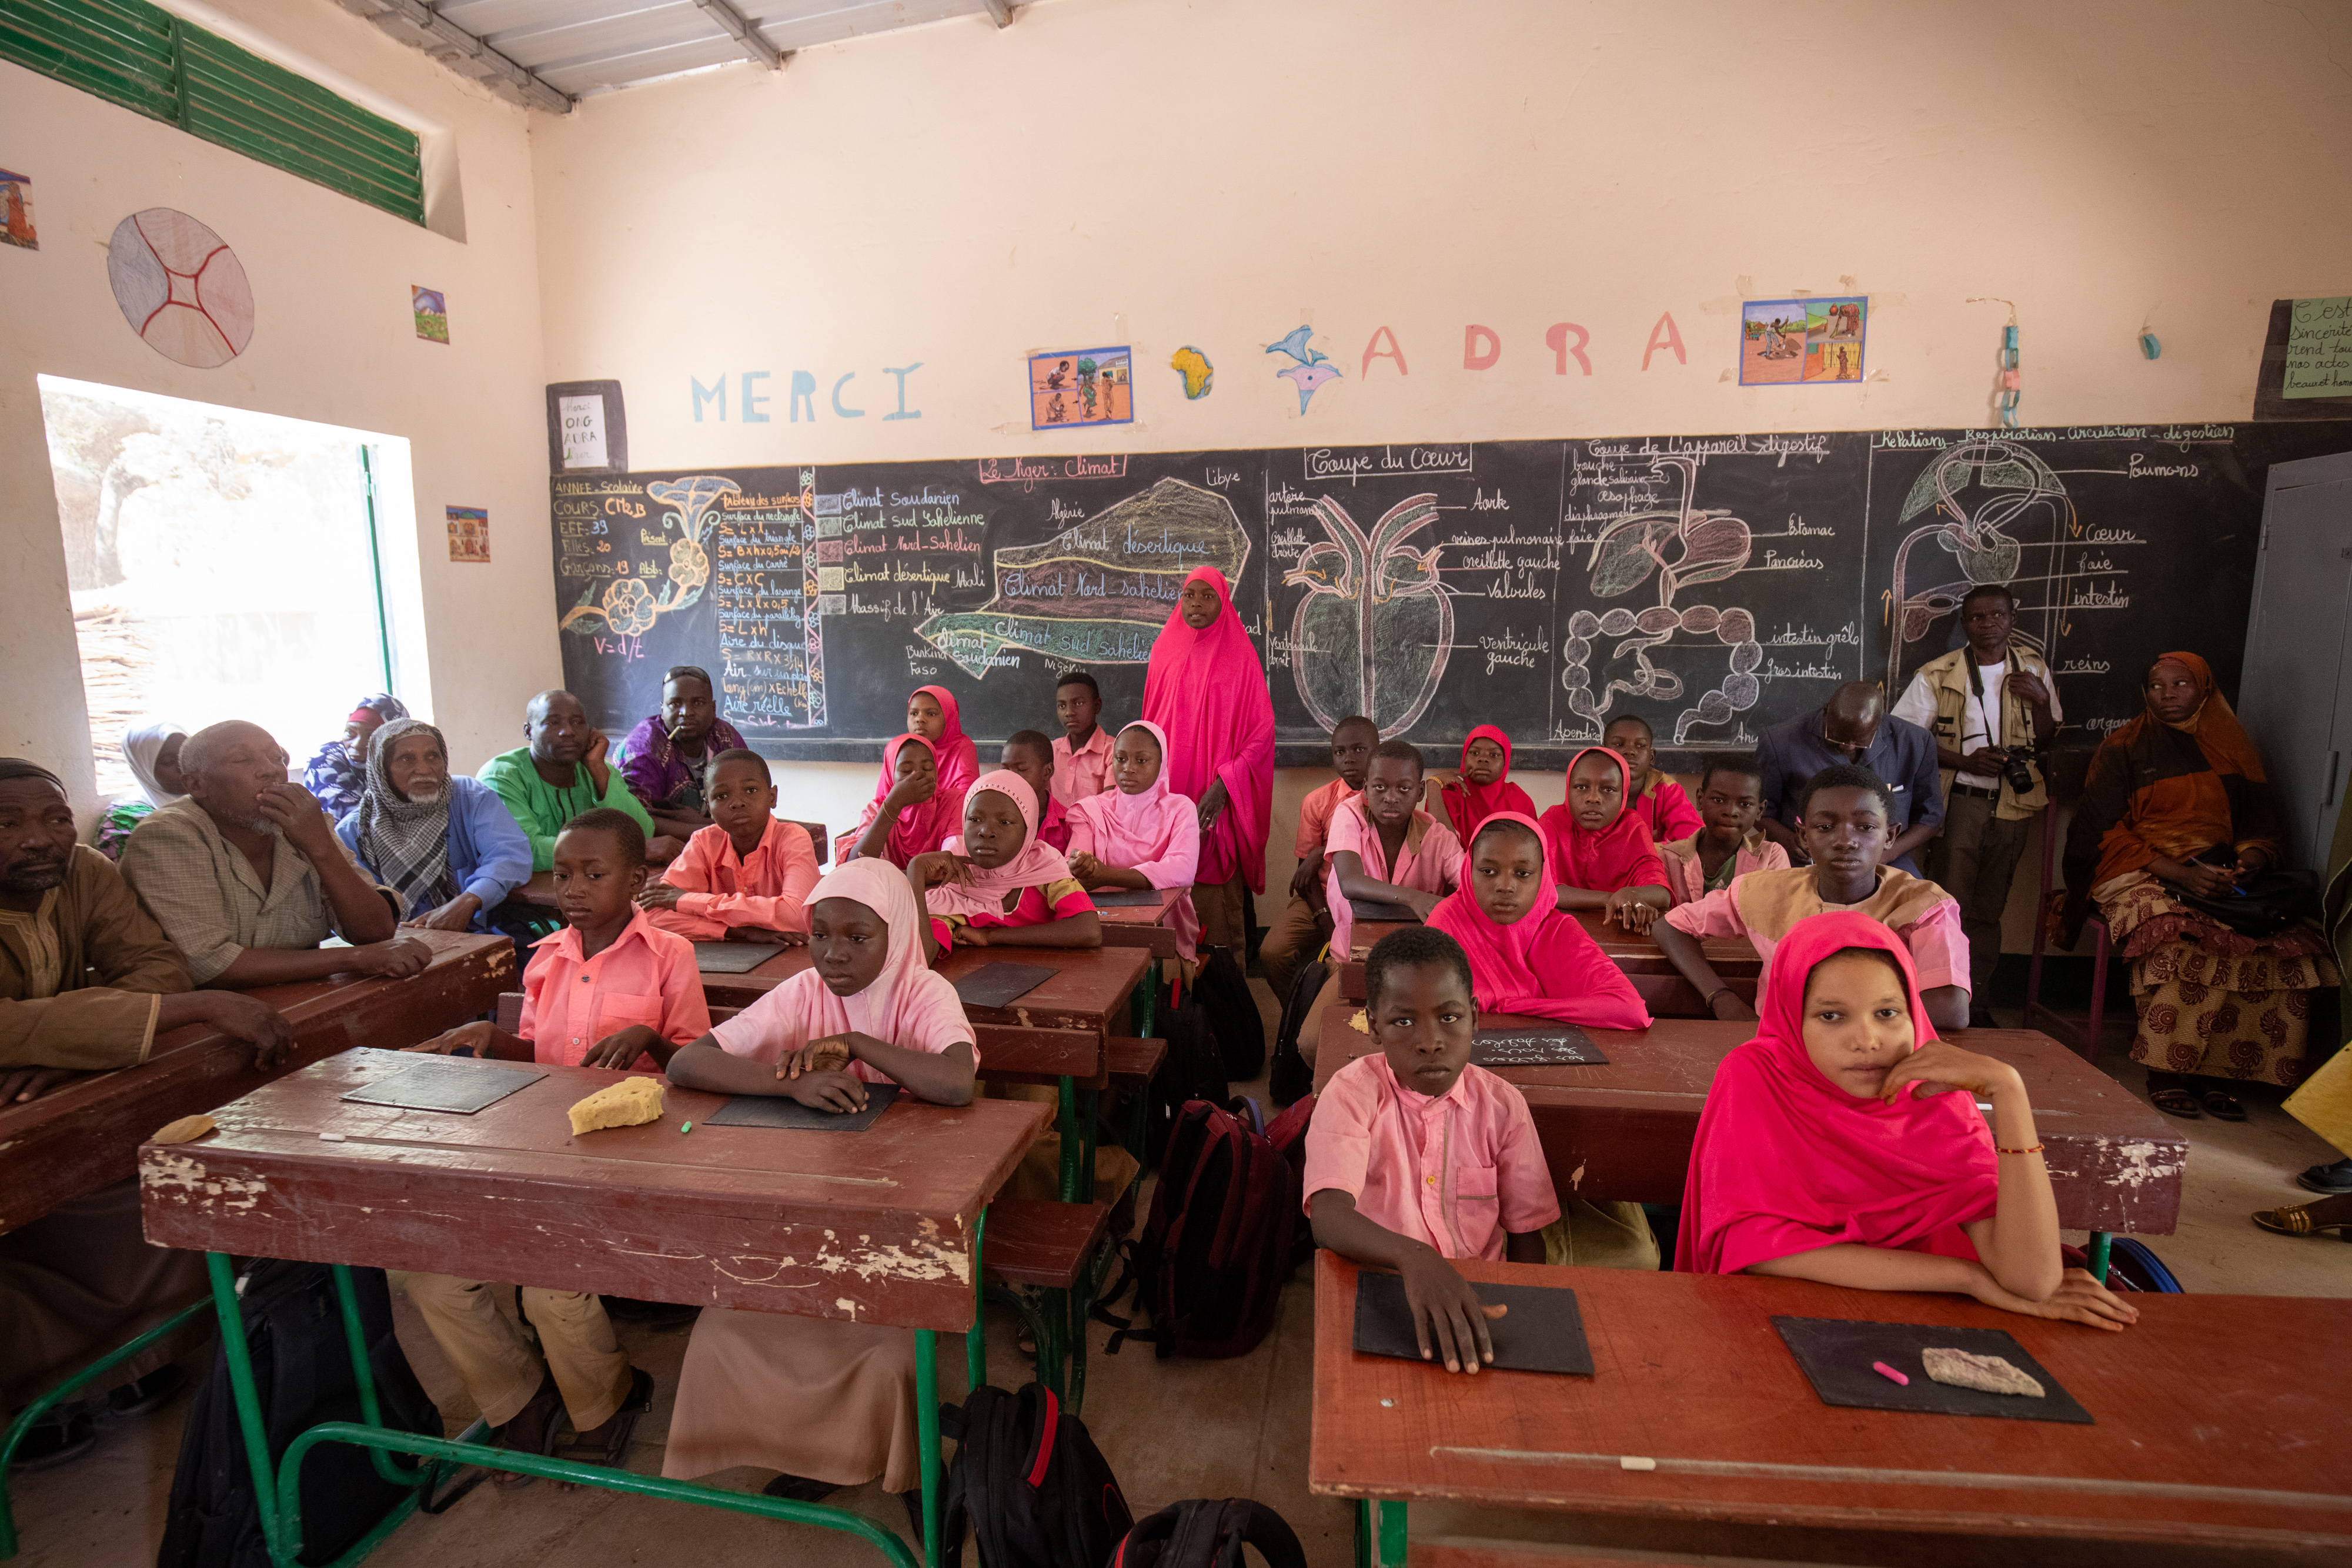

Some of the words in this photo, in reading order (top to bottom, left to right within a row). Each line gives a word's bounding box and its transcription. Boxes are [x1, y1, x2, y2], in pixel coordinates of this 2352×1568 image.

[2295, 298, 2352, 323] C'est
[1362, 312, 1686, 381] ADRA
[2288, 342, 2324, 355] rend
[2316, 355, 2349, 369] actes
[691, 362, 924, 422] MERCI
[565, 416, 592, 429] ONG
[564, 431, 597, 445] ADRA
[1639, 437, 1659, 454] de
[2164, 424, 2234, 453] digestion
[1065, 454, 1120, 477] Climat
[1307, 449, 1372, 487] Coupe
[1381, 444, 1404, 469] du
[2129, 453, 2199, 479] Poumons
[555, 482, 592, 493] ANNEE
[1207, 467, 1241, 491] Libye
[843, 487, 884, 510] Climat
[890, 486, 960, 506] Soudanien
[1471, 487, 1509, 510] Aorte
[591, 519, 609, 535] 39
[753, 510, 764, 521] du
[766, 508, 801, 527] rectangle
[843, 510, 886, 532] Climat
[1789, 513, 1835, 536] Estomac
[750, 534, 762, 544] du
[764, 529, 797, 548] triangle
[2086, 523, 2136, 542] Cœur
[596, 540, 612, 553] 20
[844, 534, 887, 555] Climat
[1061, 527, 1112, 551] Climat
[1123, 524, 1211, 567] désertique
[1271, 544, 1300, 558] droite
[753, 557, 764, 569] du
[1517, 545, 1561, 579] gauche
[2076, 550, 2113, 576] foie
[844, 561, 890, 583] Climat
[893, 559, 950, 596] désertique
[951, 563, 985, 589] Mali
[1005, 569, 1067, 597] Climat
[1487, 571, 1546, 600] Valvules
[757, 583, 769, 596] du
[2071, 580, 2129, 608] intestin
[750, 607, 761, 621] du
[848, 593, 891, 622] Massif
[893, 591, 907, 614] de
[721, 632, 746, 647] Aire
[750, 635, 764, 649] du
[995, 616, 1051, 644] Climat
[1098, 632, 1151, 661] Sahelie
[1766, 623, 1822, 644] intestin
[906, 644, 948, 660] Burkina
[1486, 650, 1535, 675] gauche
[2062, 653, 2110, 671] reins
[910, 661, 938, 676] Faso
[1792, 661, 1842, 680] intestin
[1732, 721, 1759, 745] Anu
